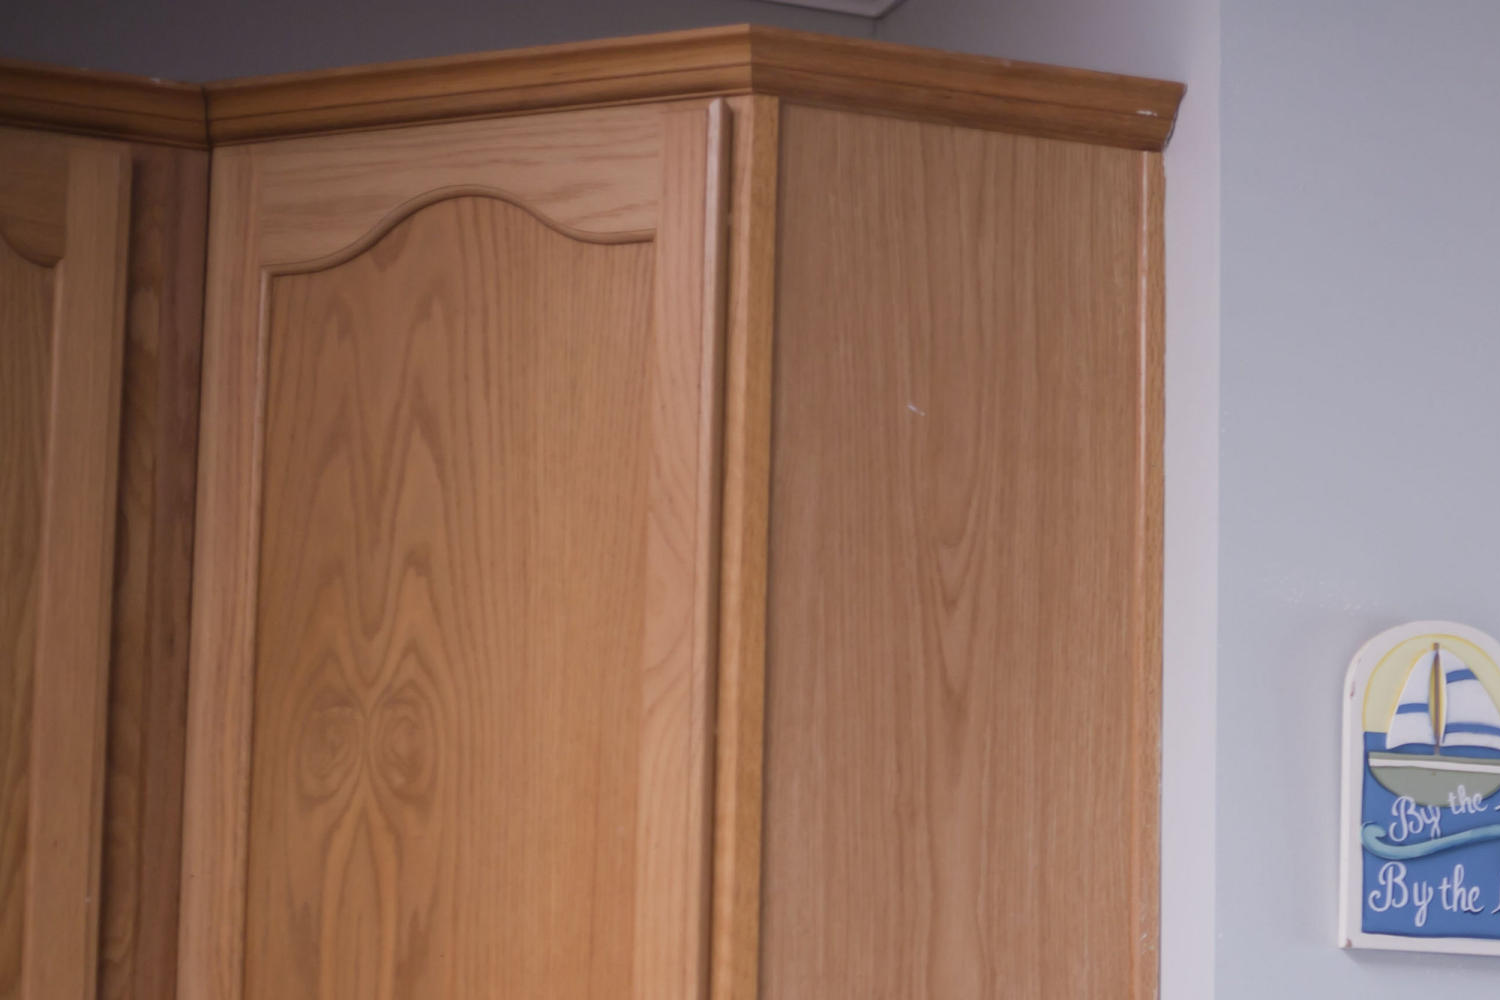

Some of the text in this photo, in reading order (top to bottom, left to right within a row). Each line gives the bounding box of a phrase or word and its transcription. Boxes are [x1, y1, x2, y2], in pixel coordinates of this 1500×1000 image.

[1389, 796, 1440, 841] By
[1448, 785, 1487, 815] the
[1368, 861, 1434, 927] By
[1438, 864, 1484, 914] the
